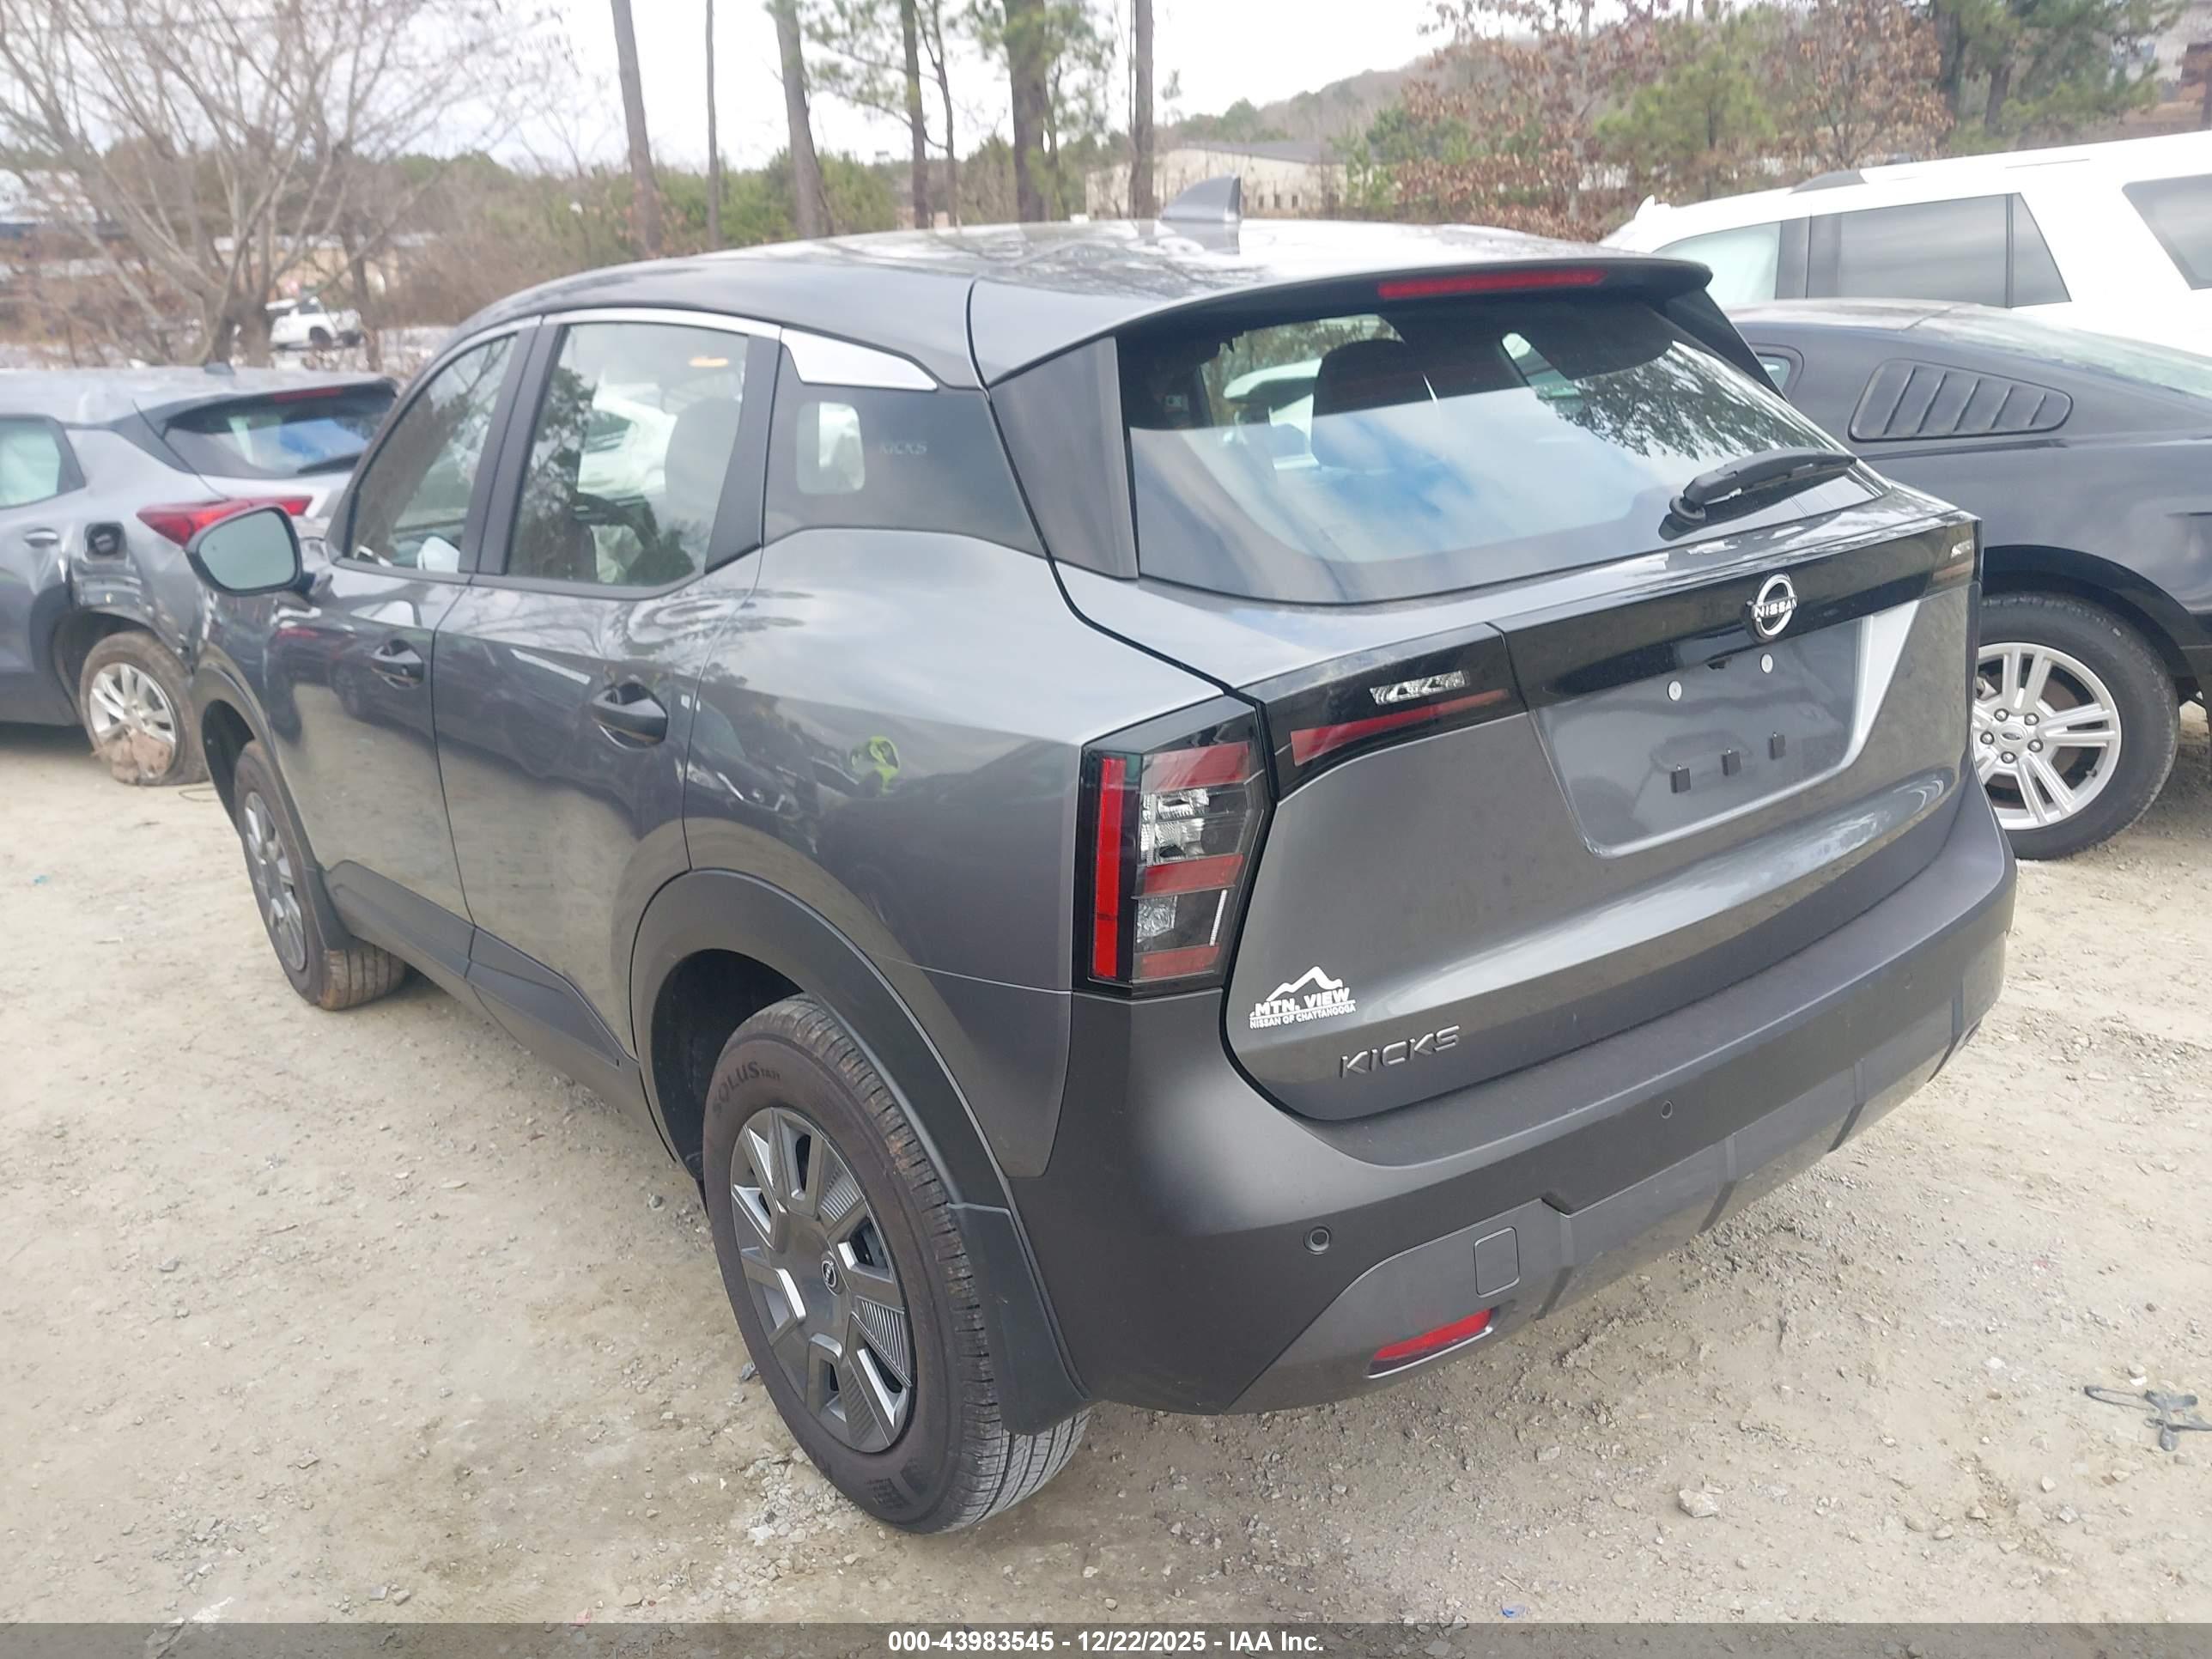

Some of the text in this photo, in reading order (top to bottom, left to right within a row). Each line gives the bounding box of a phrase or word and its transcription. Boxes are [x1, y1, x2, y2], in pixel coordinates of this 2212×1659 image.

[1754, 598, 1797, 618] NISSAN
[1255, 987, 1350, 1017] MTN. VIEW
[1249, 1003, 1357, 1030] NISSAN OF CHATTANOOGA
[1340, 1024, 1461, 1079] KICKS
